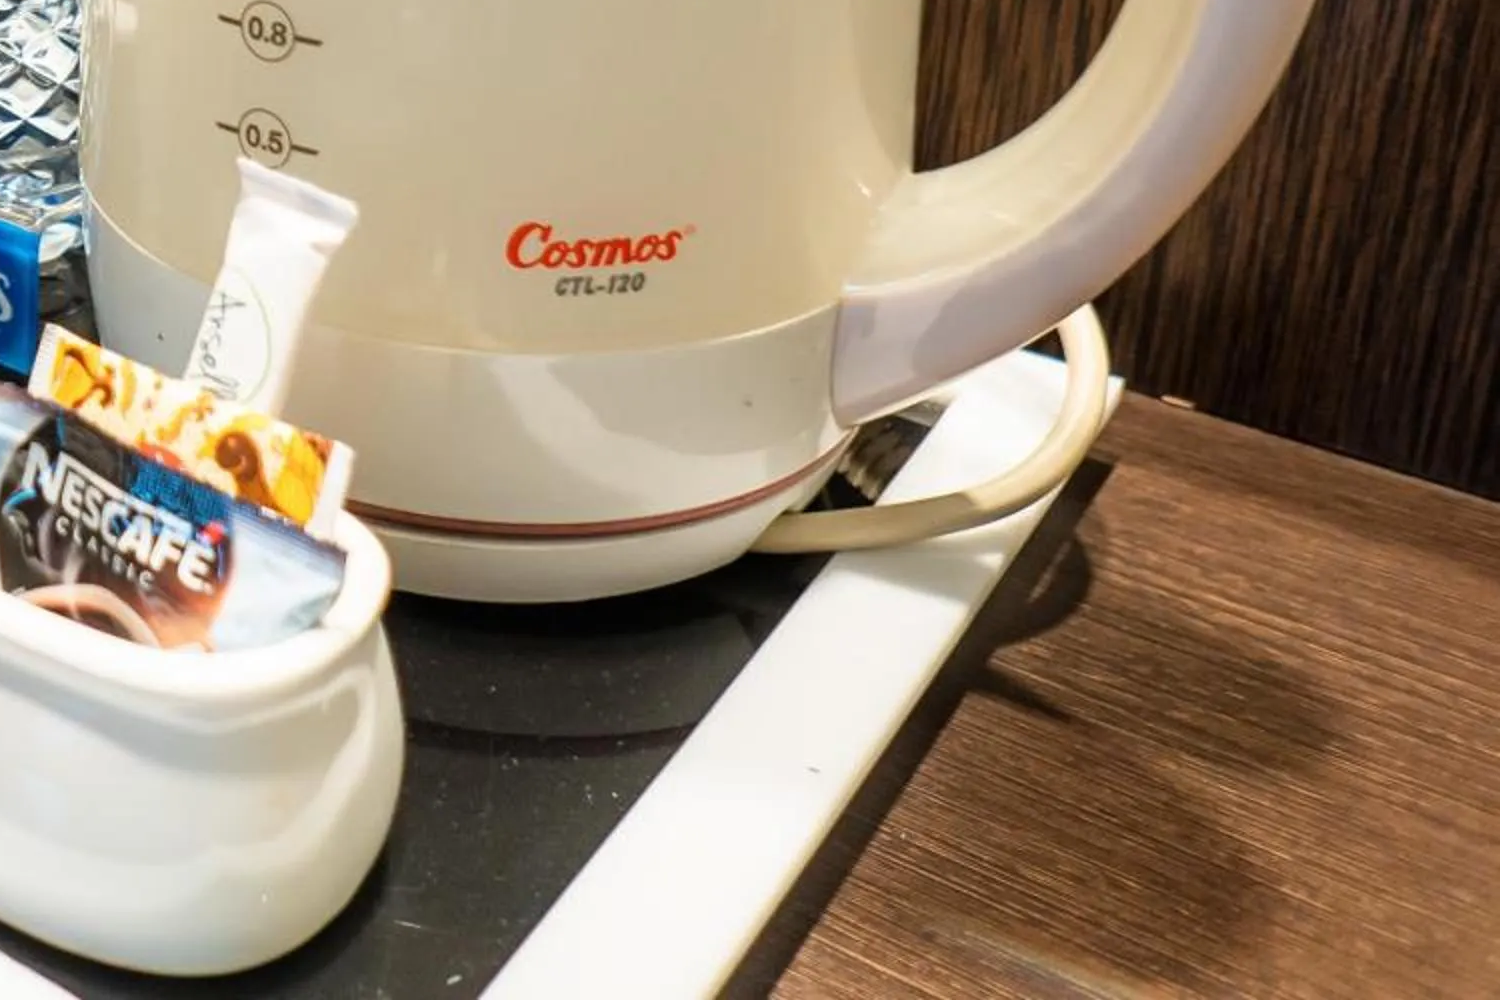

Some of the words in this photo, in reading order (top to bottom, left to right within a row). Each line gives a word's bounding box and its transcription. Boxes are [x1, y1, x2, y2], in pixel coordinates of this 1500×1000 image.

[247, 16, 288, 47] 0.8
[245, 123, 284, 154] 0.5
[505, 221, 684, 269] Cosmos
